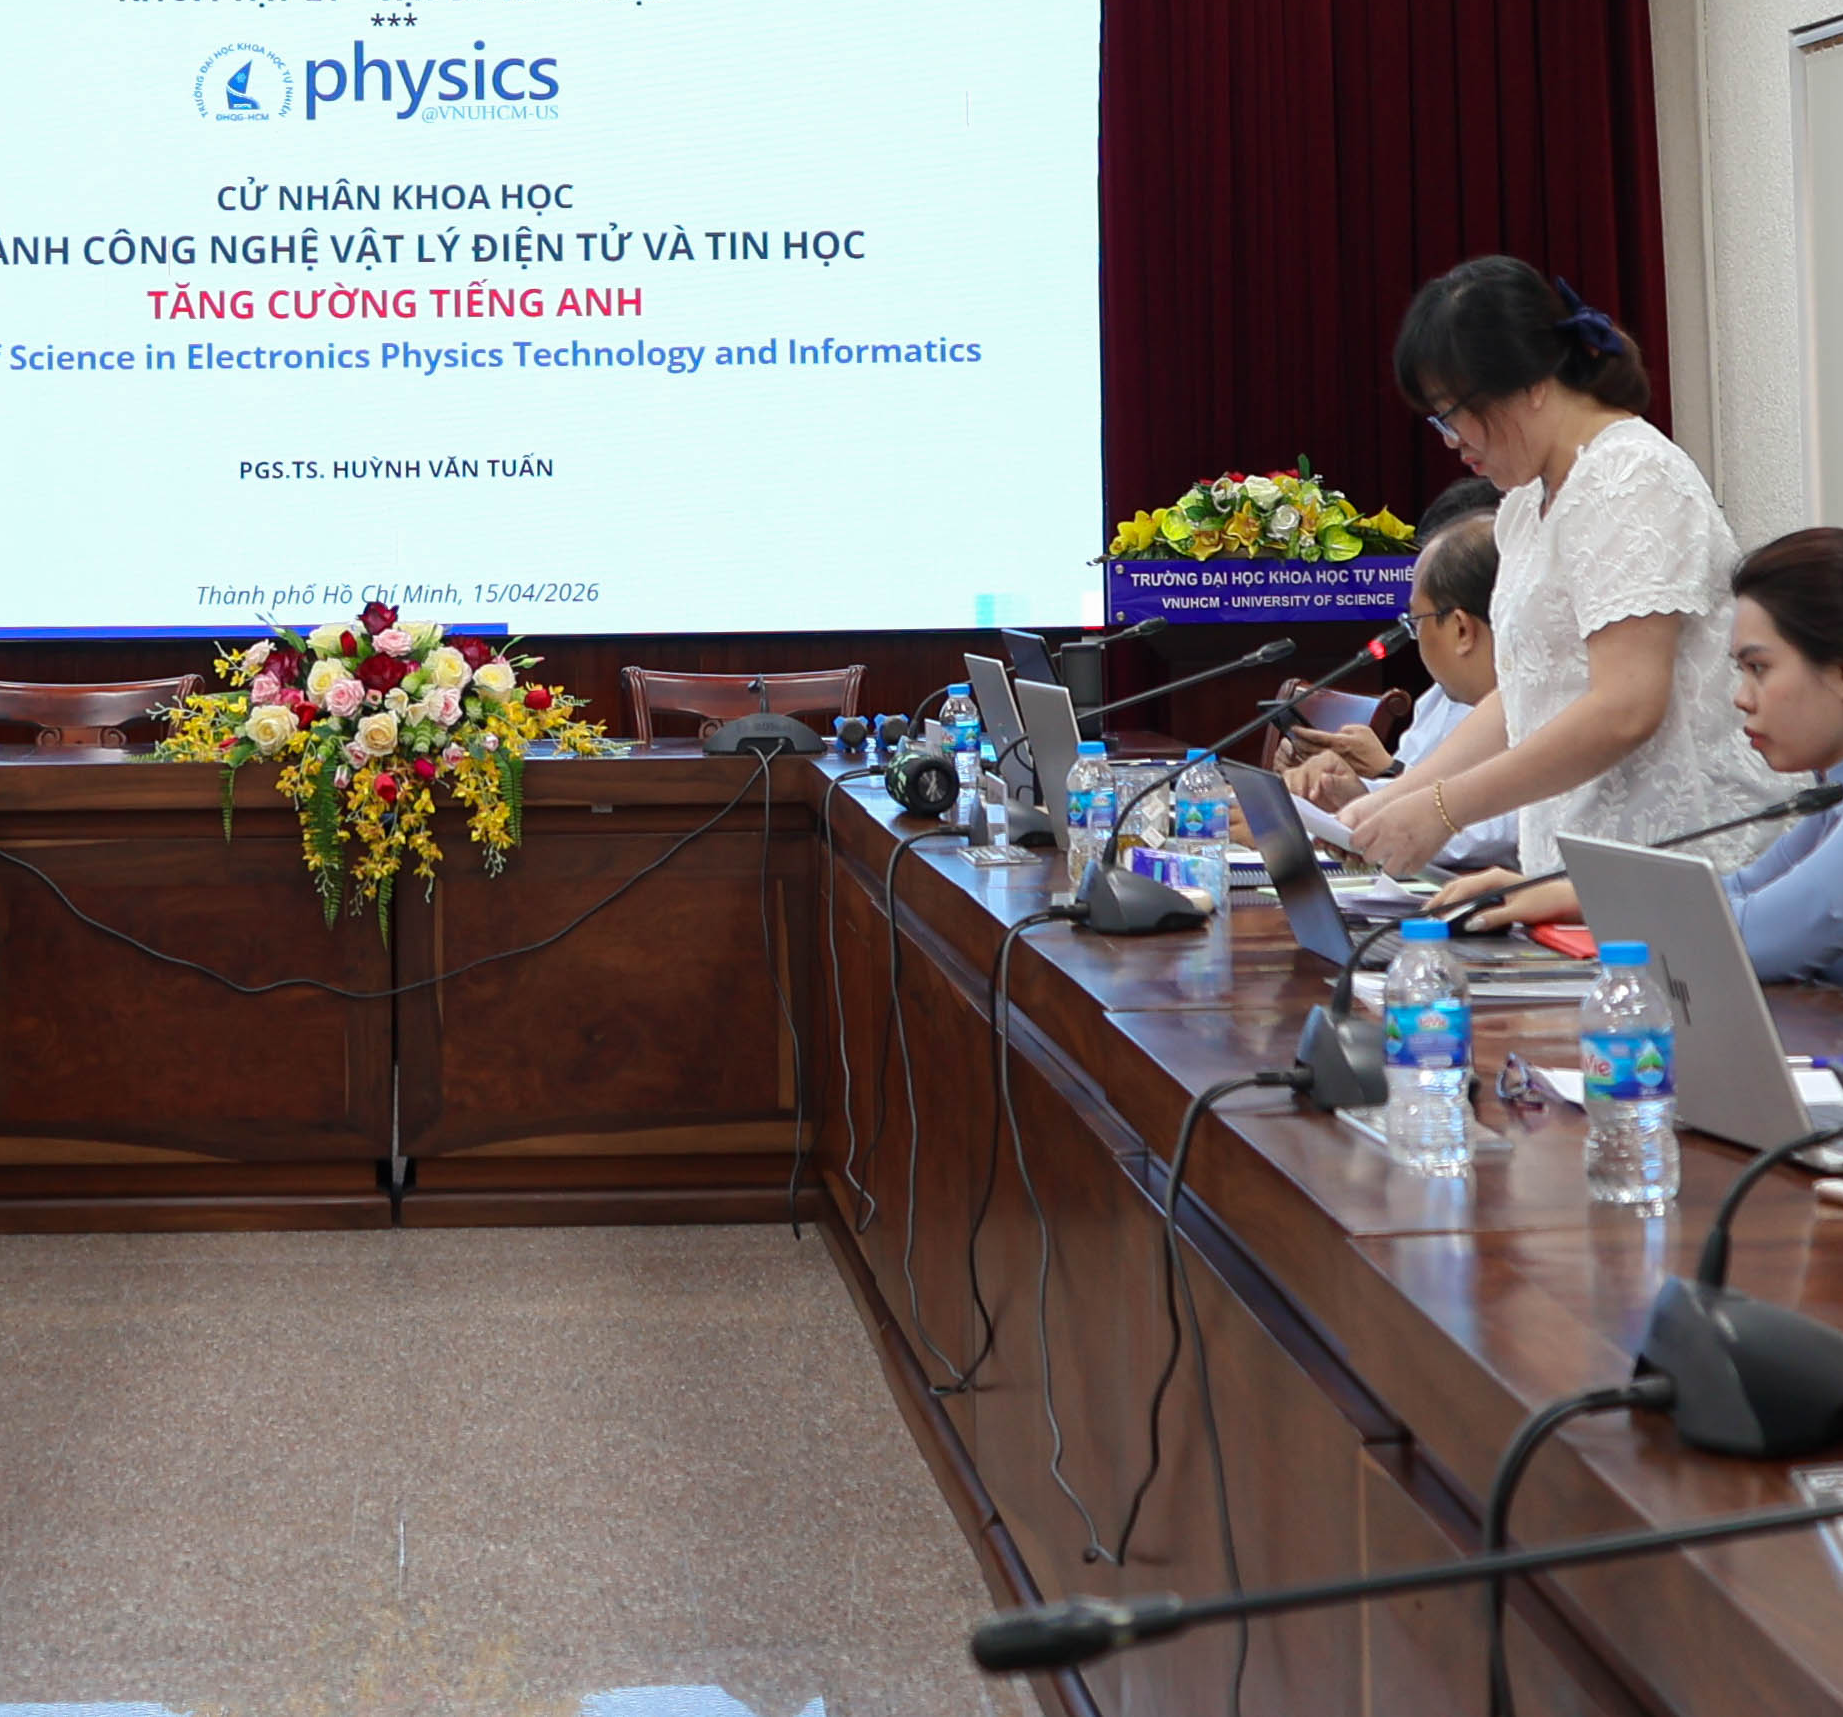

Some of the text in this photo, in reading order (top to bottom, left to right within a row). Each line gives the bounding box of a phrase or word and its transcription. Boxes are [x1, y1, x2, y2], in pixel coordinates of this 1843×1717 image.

[305, 40, 560, 121] physics
[421, 104, 559, 124] @VNUHCM-US
[217, 177, 574, 217] CỬ NHÂN KHOA HỌC
[84, 228, 196, 266] CÔNG
[210, 227, 319, 271] NGHỆ
[330, 226, 406, 271] VẬT
[418, 226, 460, 263] LÝ
[471, 225, 564, 270] ĐIỆN
[576, 222, 633, 263] TỬ
[643, 224, 696, 261] VÀ
[706, 231, 769, 261] TIN
[783, 230, 866, 268] HỌC
[146, 279, 642, 320] TĂNG CƯỜNG TIẾNG ANH
[9, 343, 136, 371] Science
[145, 343, 176, 370] in
[187, 342, 371, 370] Electronics
[381, 341, 504, 376] Physics
[512, 338, 706, 375] Technology
[715, 338, 778, 366] and
[789, 336, 983, 365] Informatics
[239, 453, 554, 480] PGS.TS. HUỲNH VĂN TUẤN
[1131, 565, 1415, 588] TRƯỜNG ĐẠI HỌC KHOA HỌC TỰ NHIÊ
[197, 582, 600, 610] Thành phố Hồ Chí Minh, 15/04/2026
[1161, 596, 1220, 609] VNUHCM
[1231, 594, 1311, 608] UNIVERSITY
[1314, 594, 1333, 606] OF
[1336, 593, 1395, 606] SCIENCE
